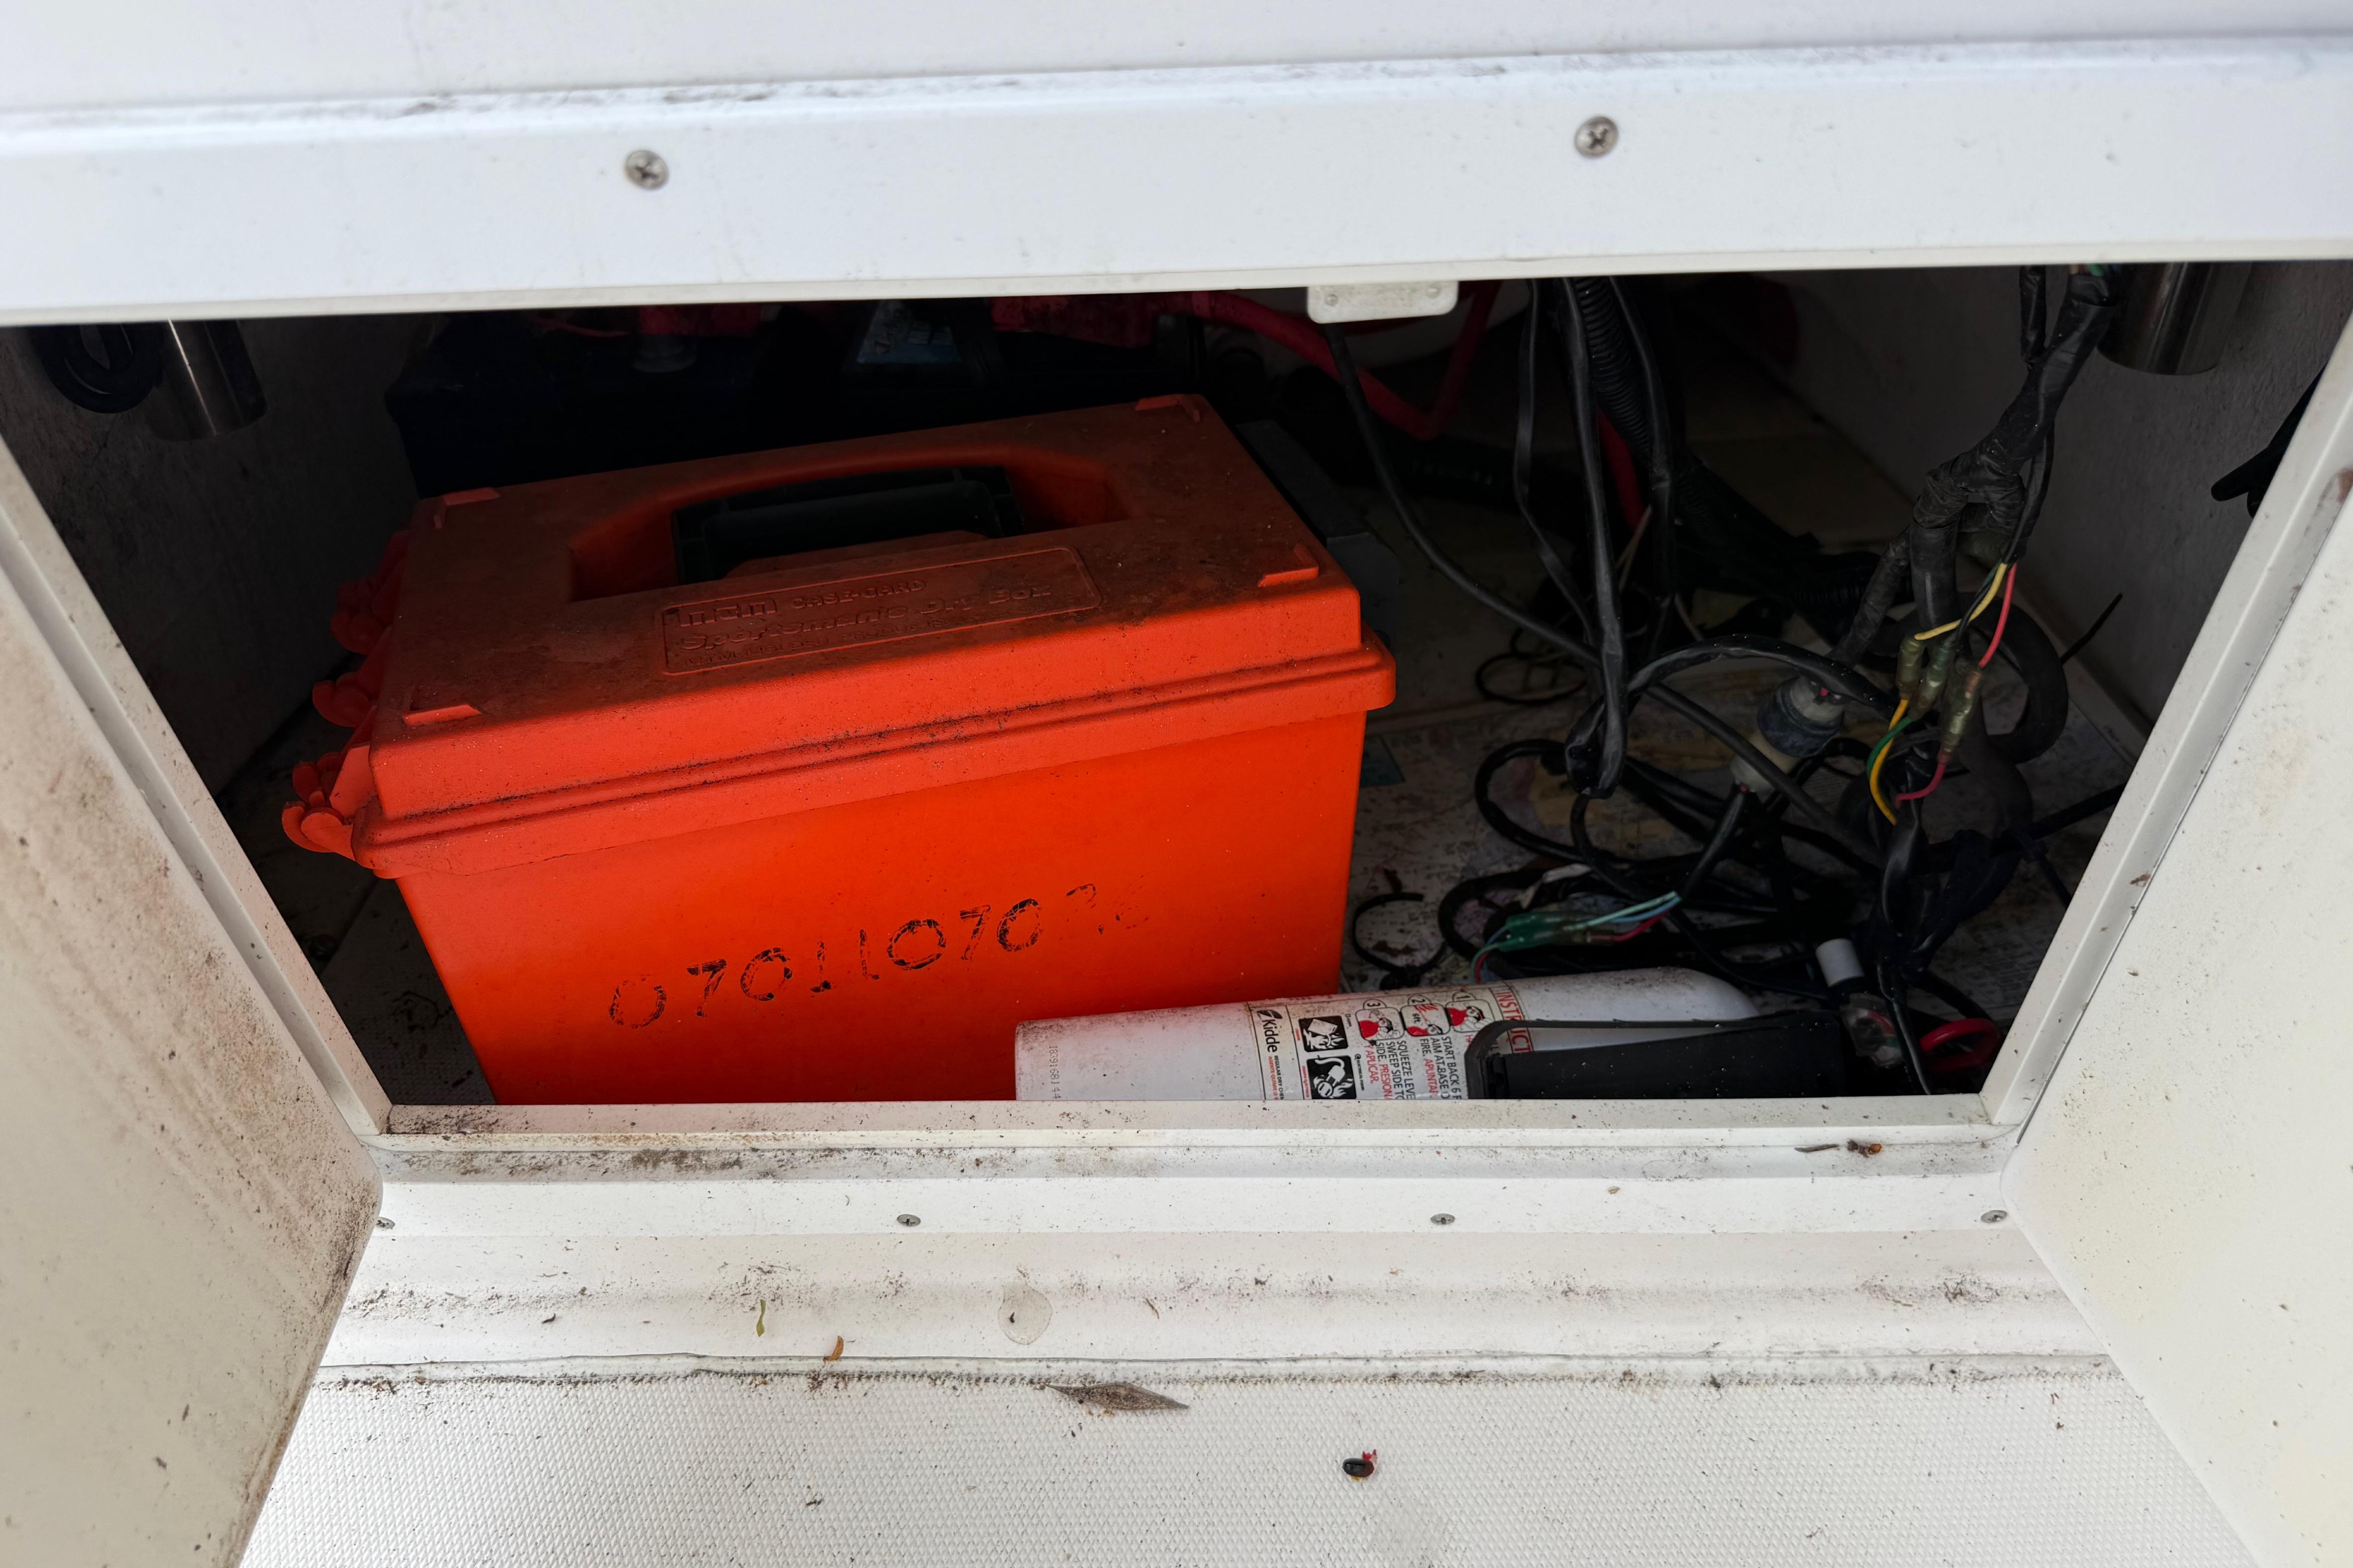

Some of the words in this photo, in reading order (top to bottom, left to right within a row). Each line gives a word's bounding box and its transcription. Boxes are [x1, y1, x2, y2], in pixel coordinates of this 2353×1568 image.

[1262, 1019, 1280, 1053] Kidde
[1420, 1038, 1430, 1057] FIRE.
[1441, 1036, 1456, 1060] START
[1365, 1050, 1379, 1083] APLICAR.
[1386, 1042, 1400, 1069] SWEEP
[1431, 1038, 1443, 1053] AIM
[1437, 1068, 1450, 1089] BASE
[1391, 1070, 1403, 1089] SIDE
[1397, 1040, 1411, 1077] SQUEEZE
[1405, 1078, 1415, 1099] LEVE
[1446, 1063, 1460, 1085] BACK
